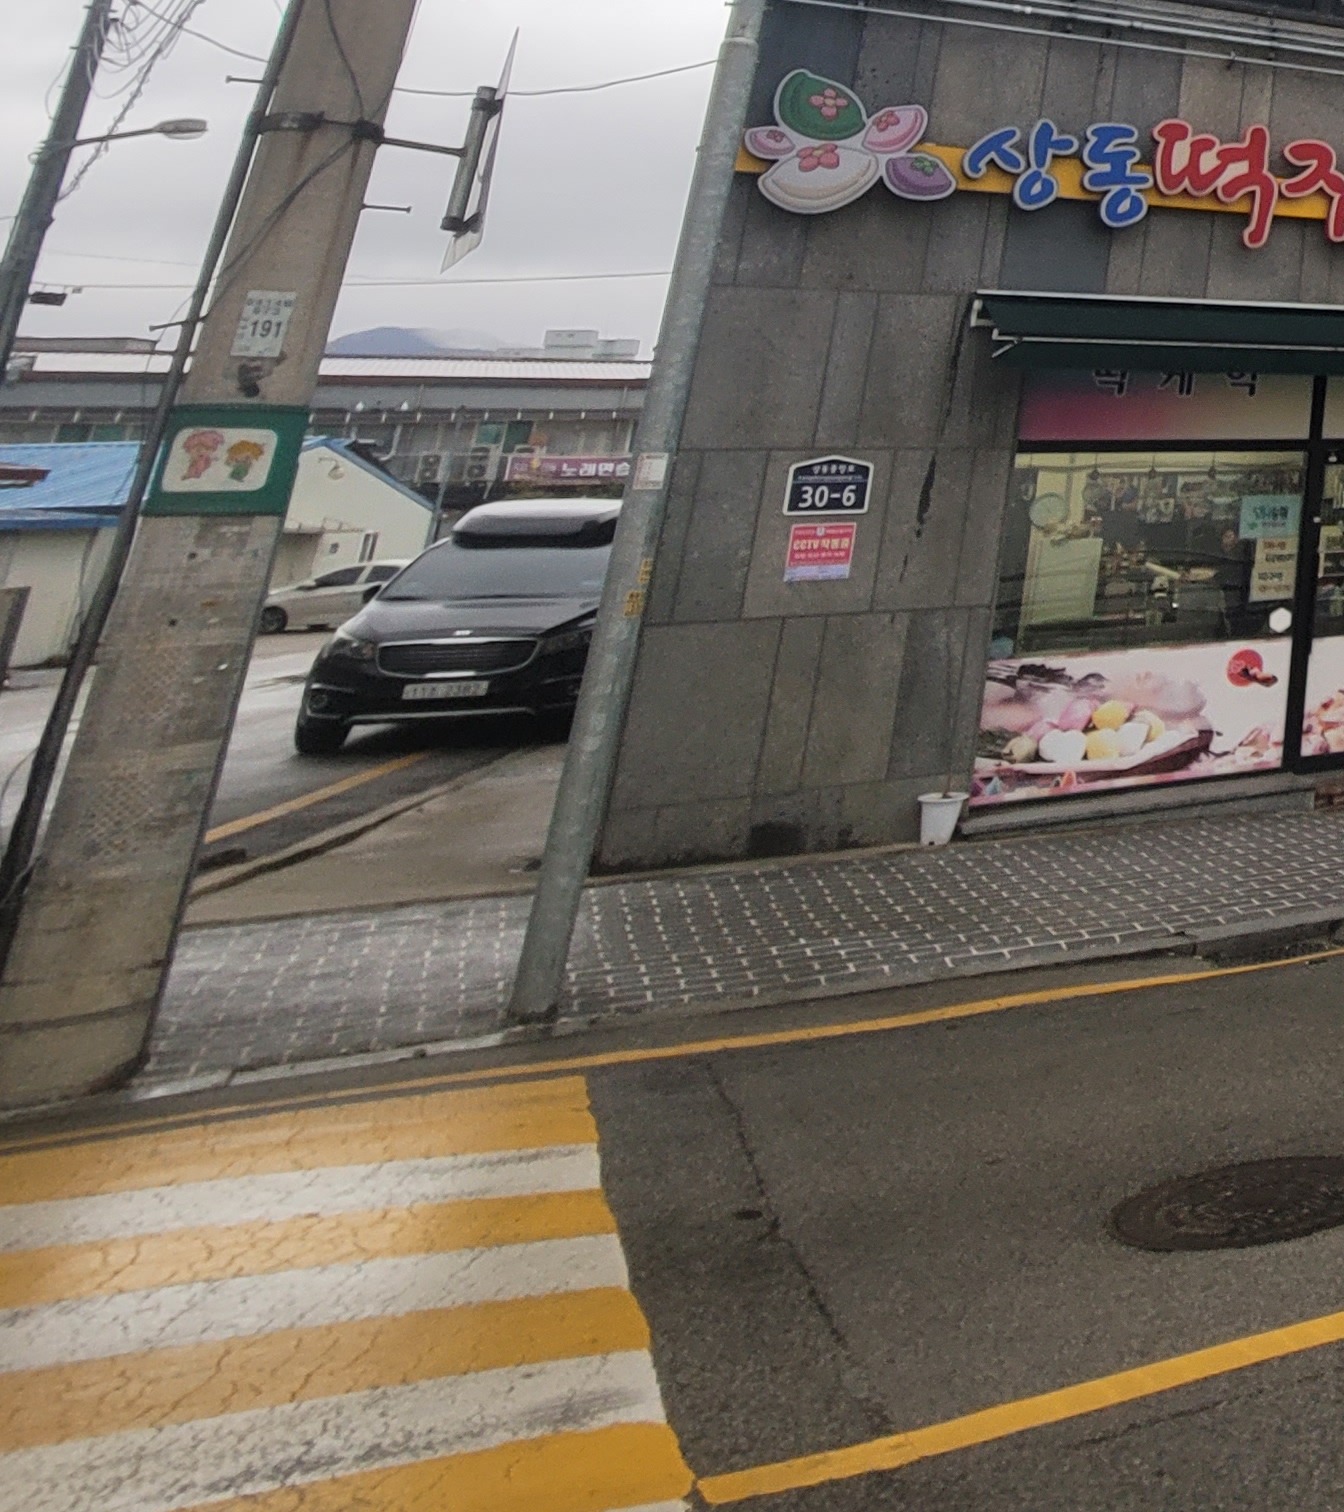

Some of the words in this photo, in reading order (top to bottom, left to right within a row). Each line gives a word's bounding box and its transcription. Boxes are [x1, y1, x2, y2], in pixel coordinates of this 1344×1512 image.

[251, 320, 282, 338] 191
[798, 485, 857, 508] 30-6
[793, 539, 819, 551] CCTV
